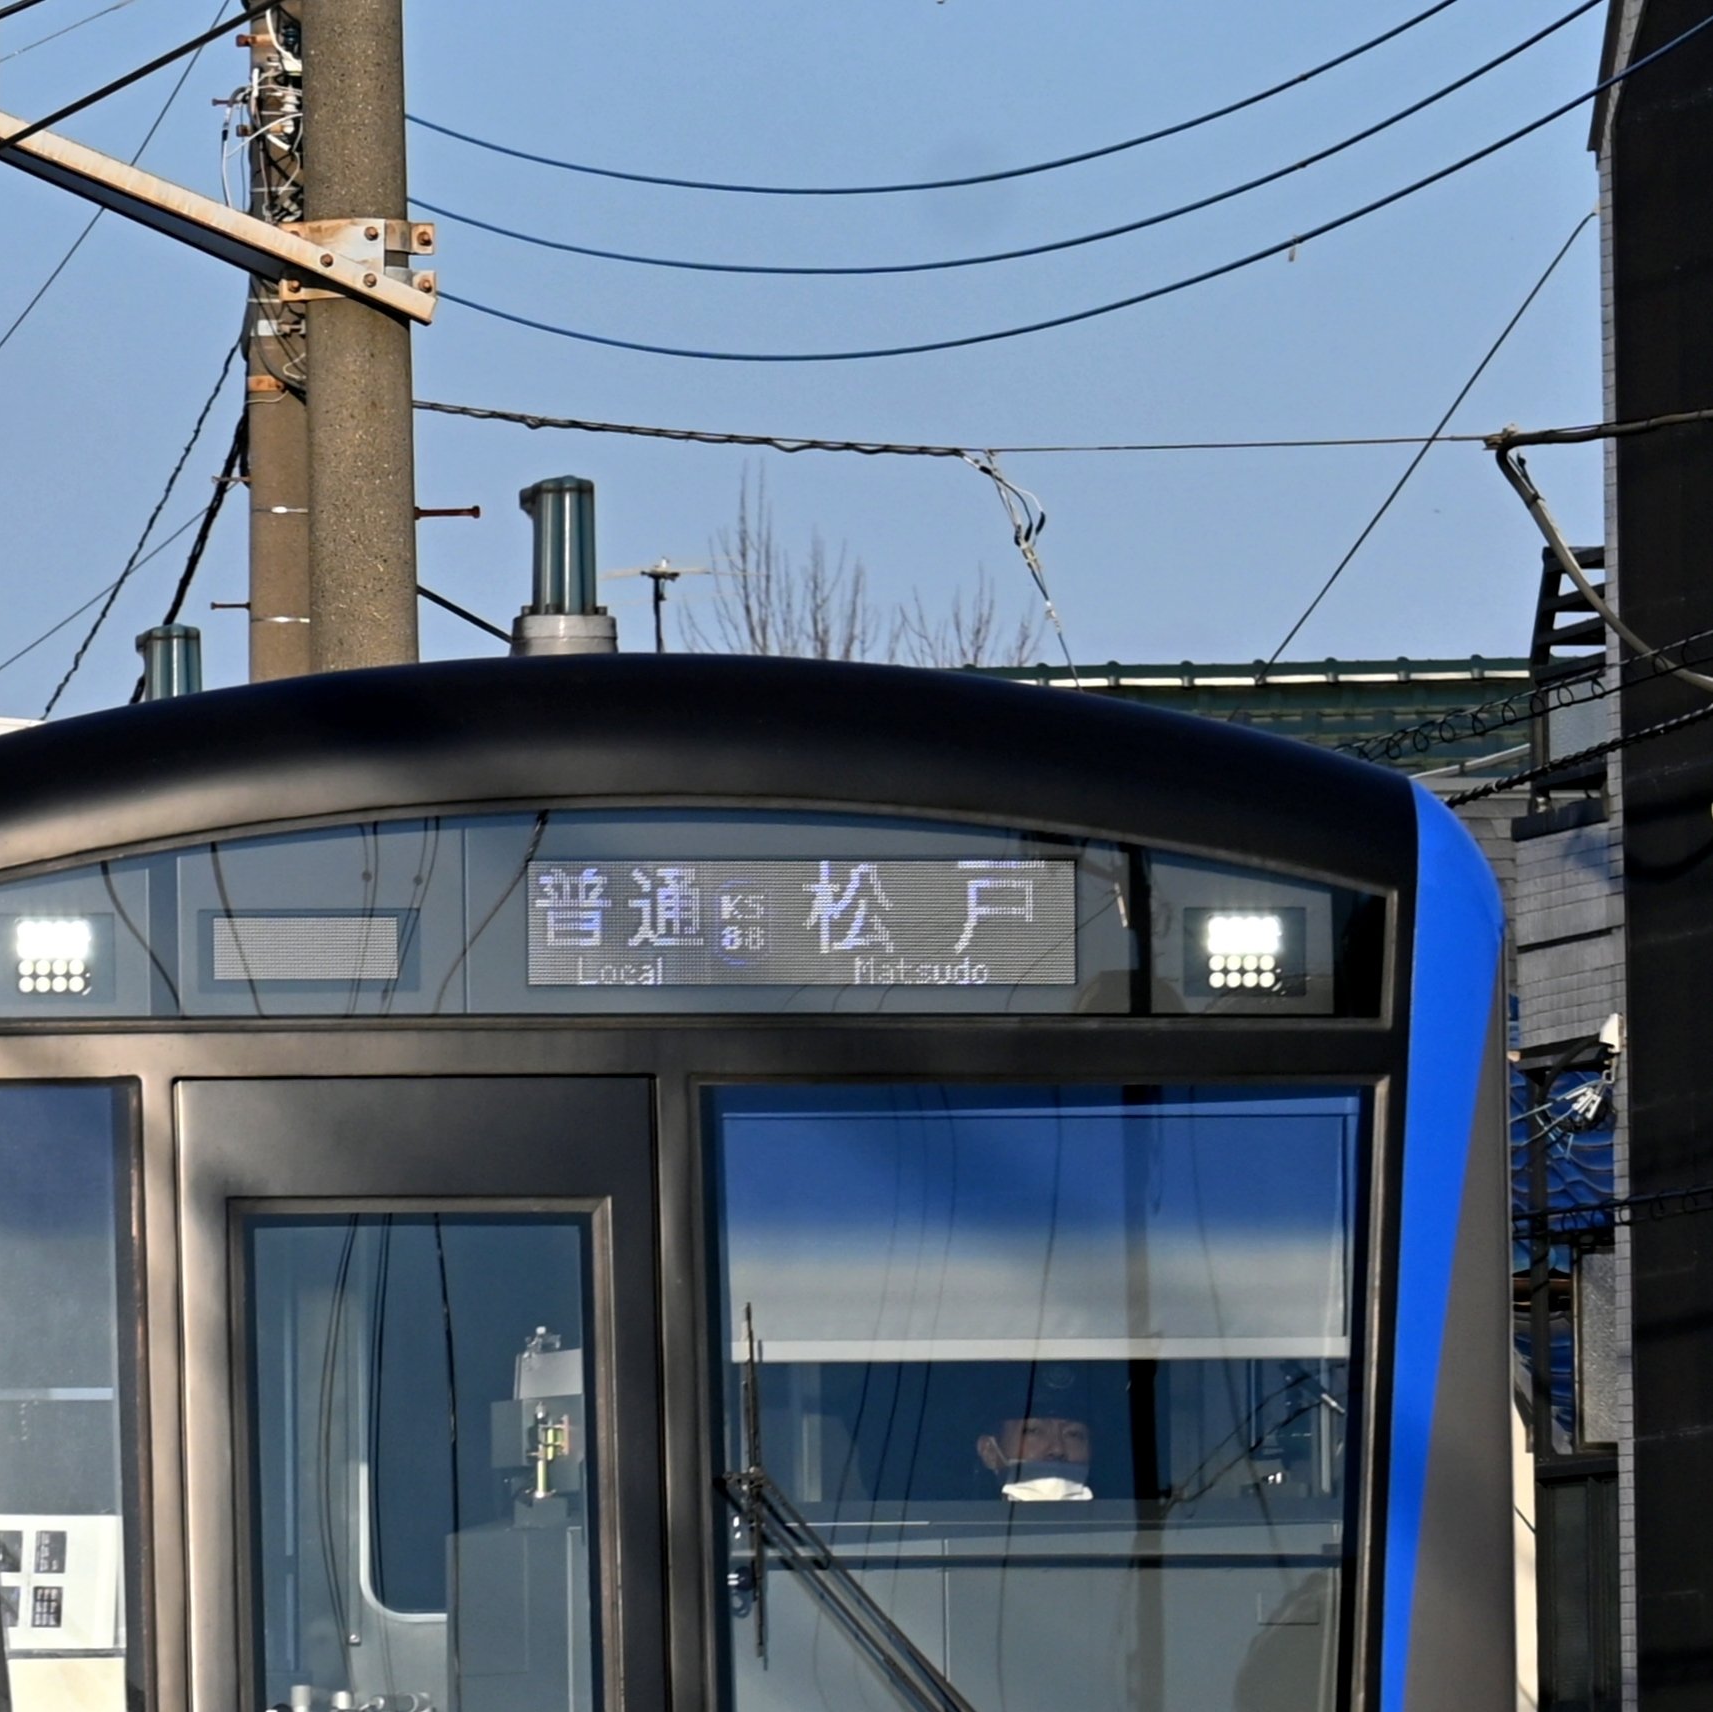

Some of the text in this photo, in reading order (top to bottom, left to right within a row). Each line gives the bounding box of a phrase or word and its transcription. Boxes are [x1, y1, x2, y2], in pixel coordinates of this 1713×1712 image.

[535, 861, 1045, 954] 普通 松戸
[720, 895, 764, 919] KS
[578, 957, 662, 985] Local
[854, 957, 988, 985] Matsudo
